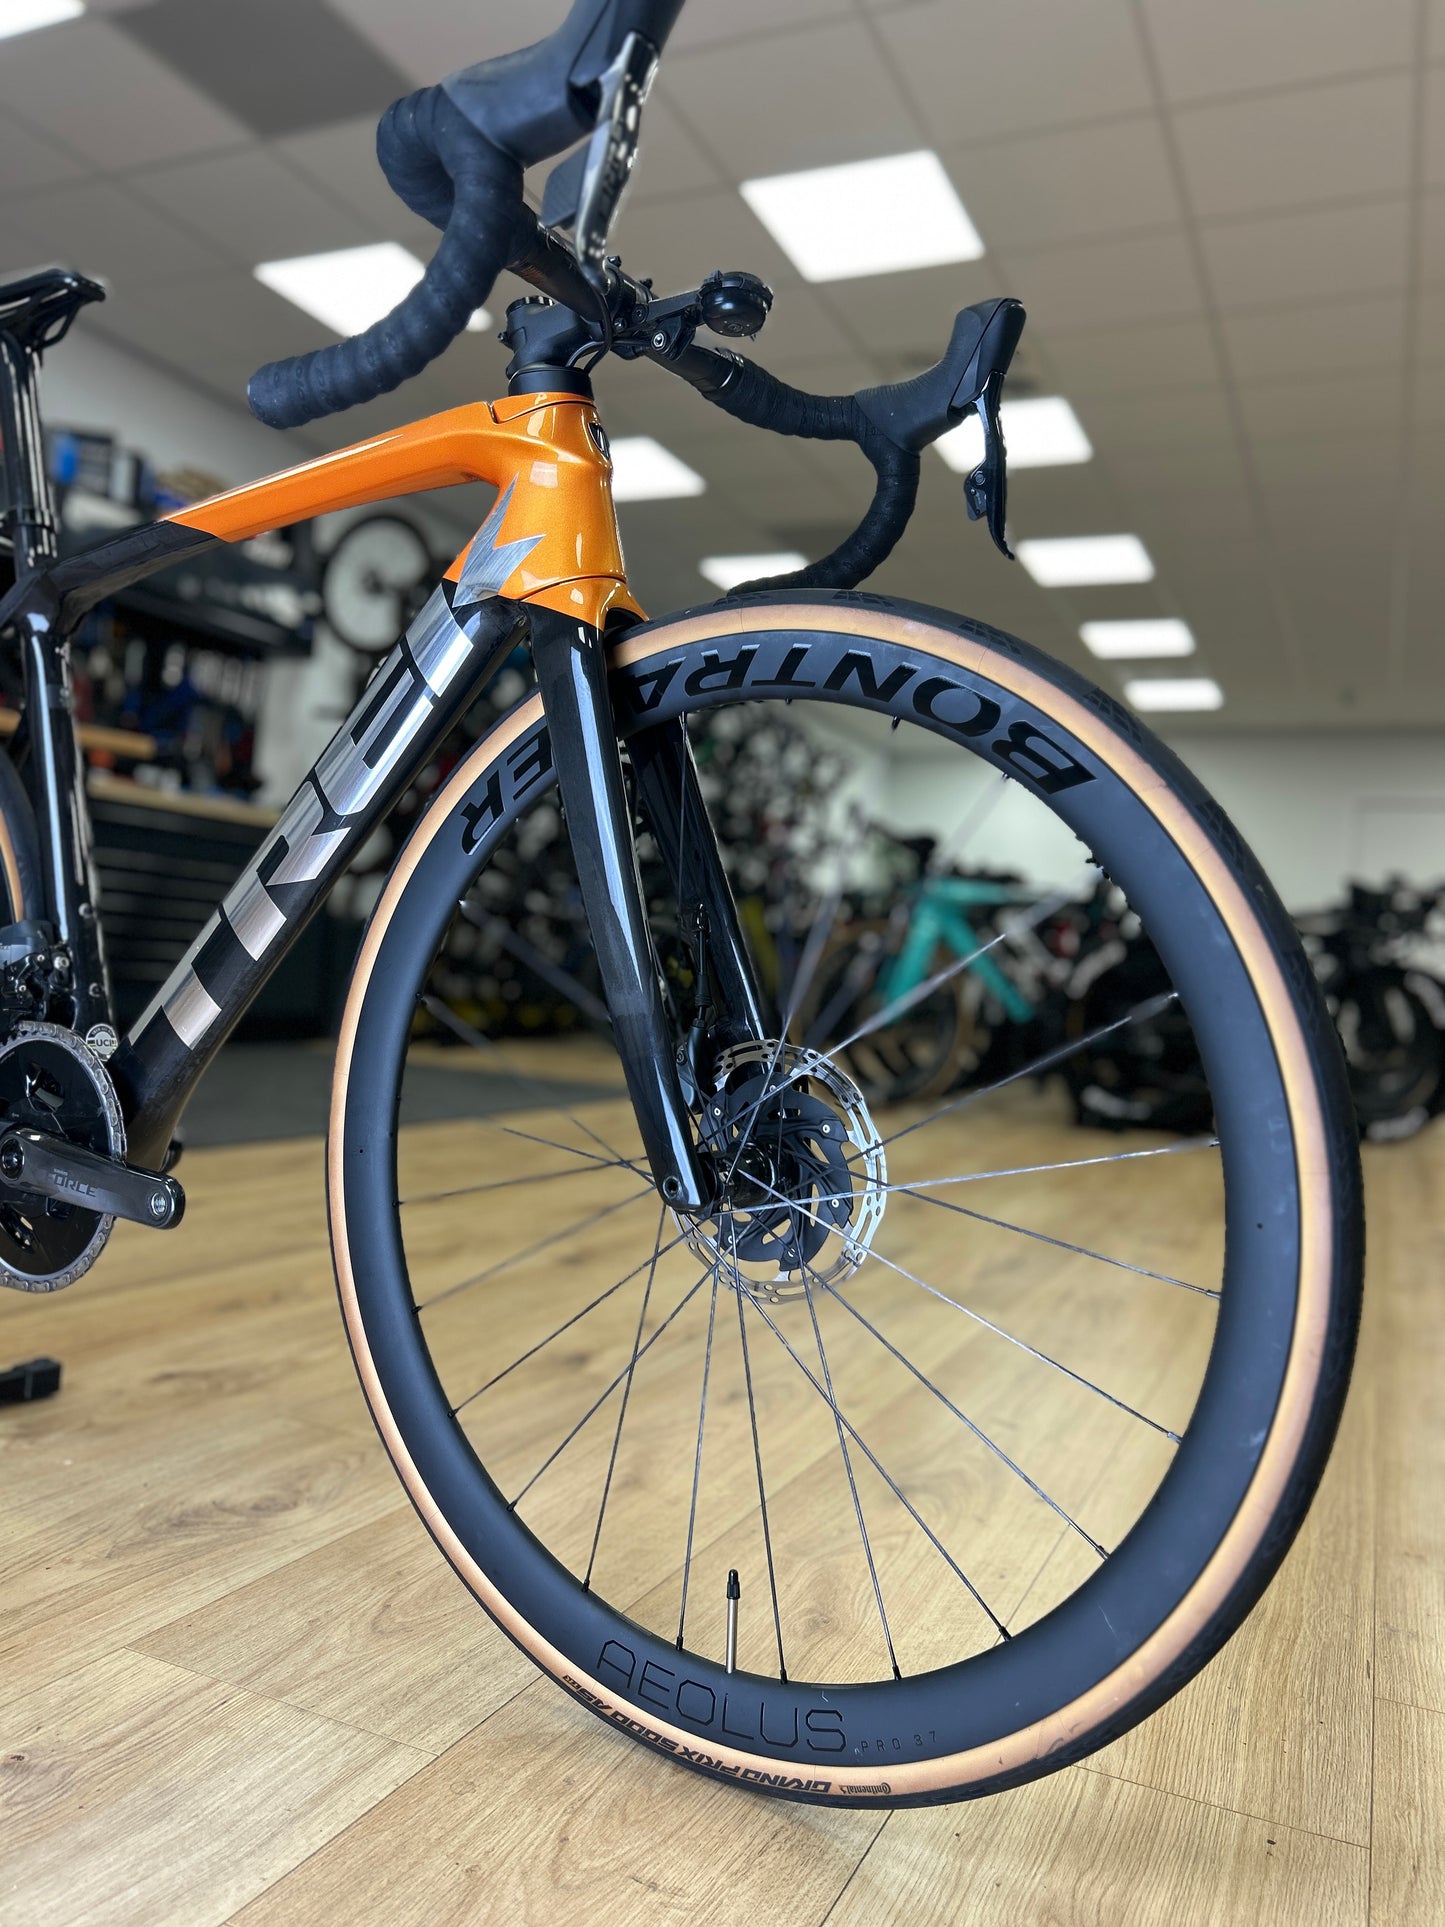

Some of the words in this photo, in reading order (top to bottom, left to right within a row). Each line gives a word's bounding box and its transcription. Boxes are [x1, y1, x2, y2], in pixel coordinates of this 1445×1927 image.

[128, 471, 547, 1050] TREK
[462, 643, 1097, 856] BONTRAER
[95, 1039, 113, 1047] UCI
[575, 1687, 613, 1711] AS
[596, 1638, 847, 1752] AEOLUS
[609, 1709, 680, 1752] 5000
[860, 1737, 901, 1753] PRO
[913, 1730, 937, 1747] 37
[678, 1744, 742, 1777] PRIX
[740, 1767, 833, 1793] GRAND
[847, 1782, 892, 1795] Continental
